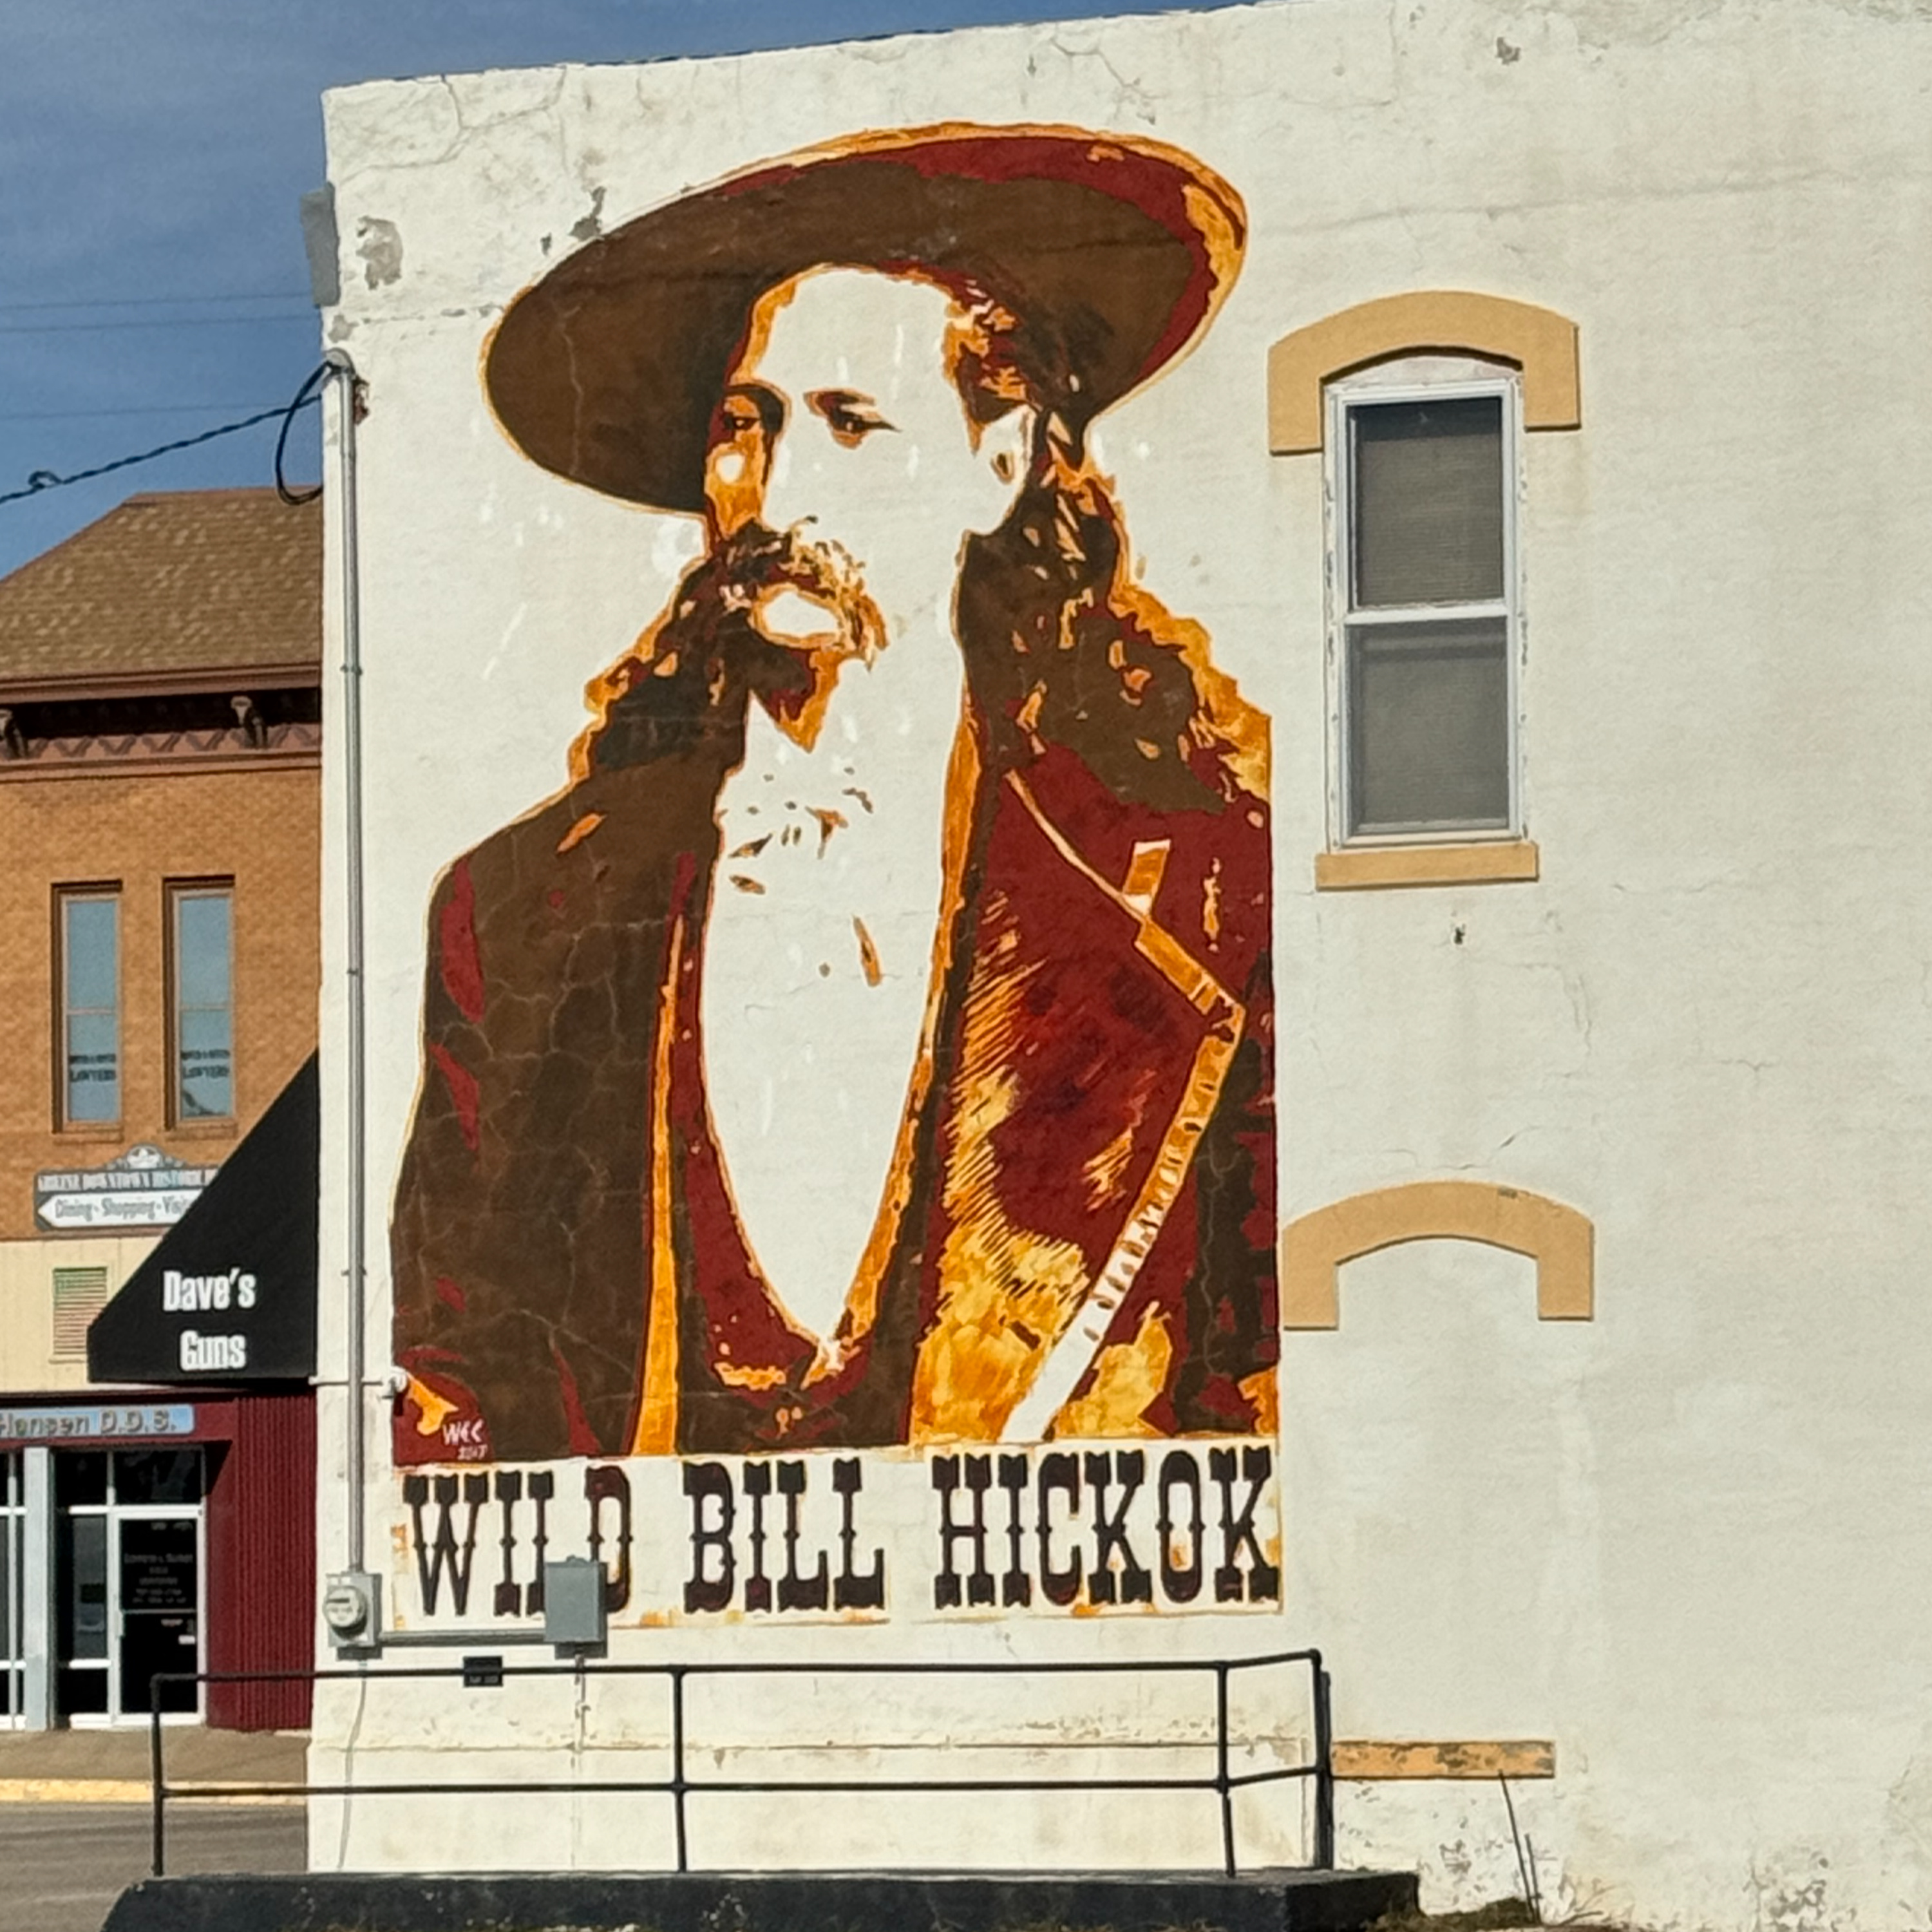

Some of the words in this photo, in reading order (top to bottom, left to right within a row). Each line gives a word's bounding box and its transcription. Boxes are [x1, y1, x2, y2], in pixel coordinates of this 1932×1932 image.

[163, 1267, 256, 1311] Dave's
[180, 1330, 246, 1371] Guns
[682, 1457, 885, 1614] BILL
[931, 1445, 1279, 1610] HICKOK
